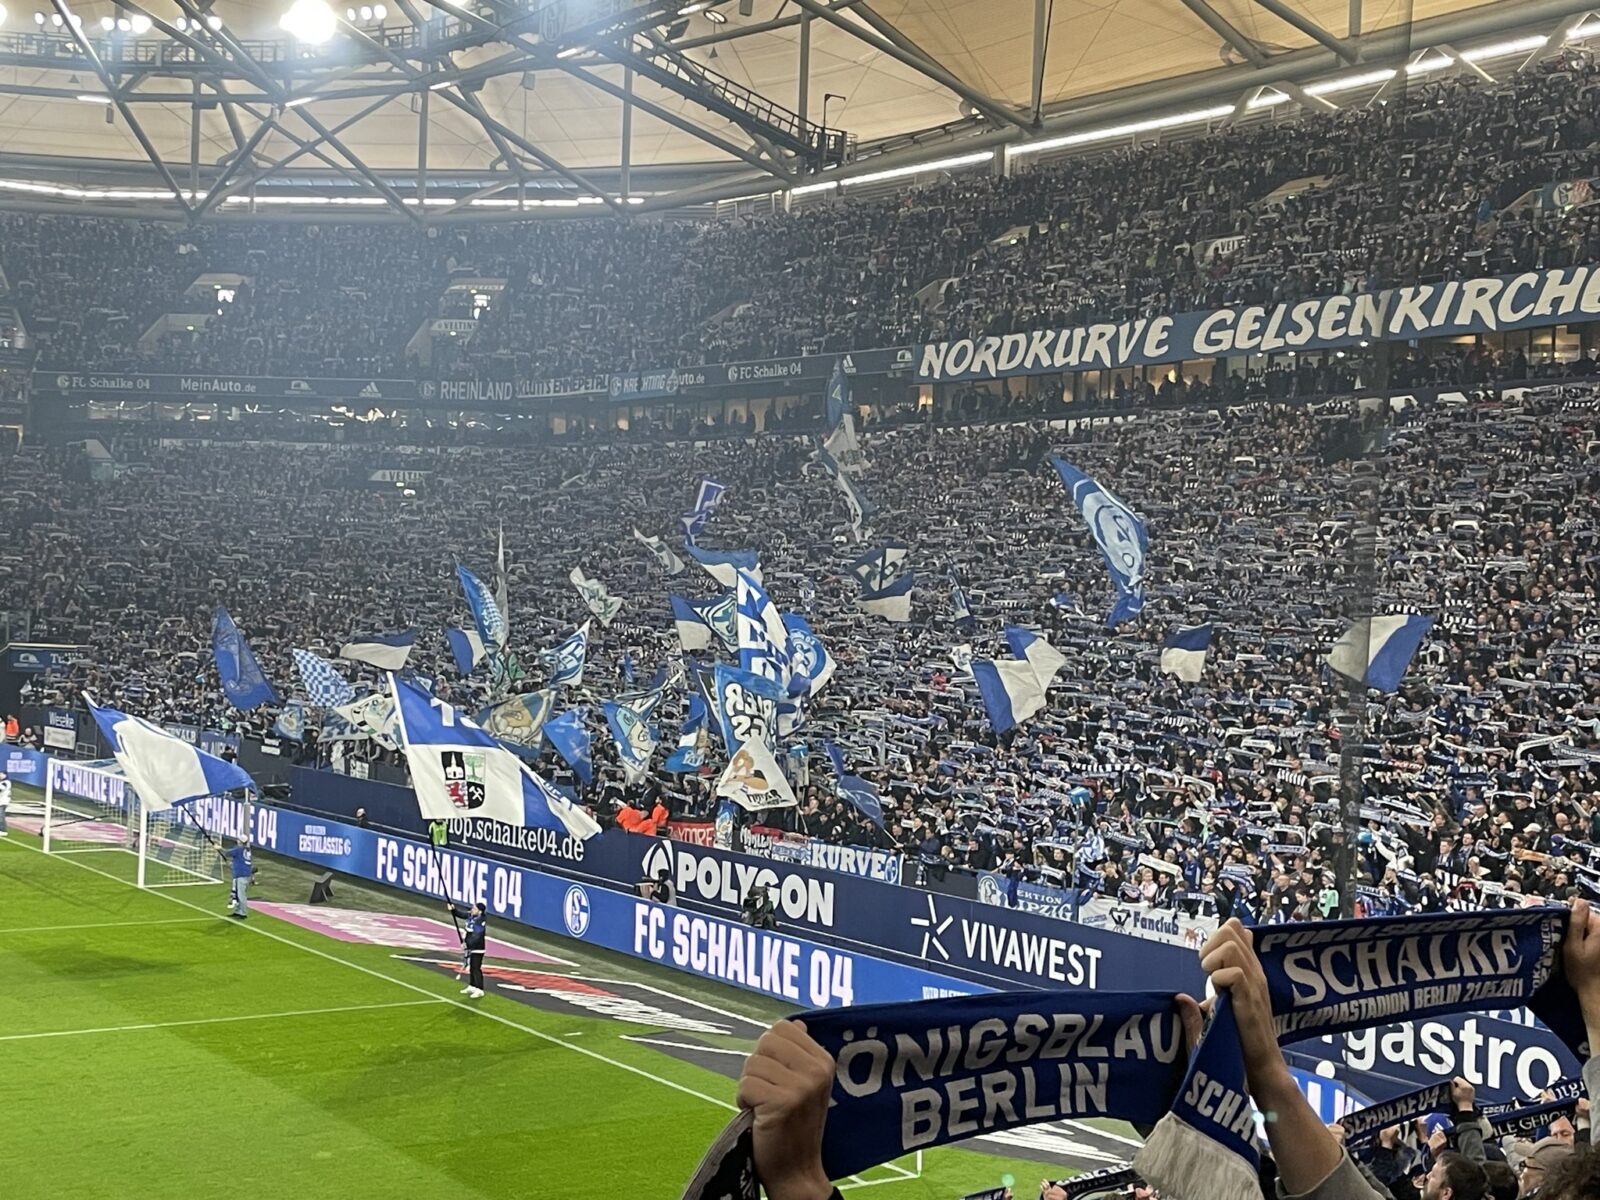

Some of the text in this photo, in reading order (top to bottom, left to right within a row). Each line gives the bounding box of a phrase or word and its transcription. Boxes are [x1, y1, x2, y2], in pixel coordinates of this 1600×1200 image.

[740, 361, 802, 379] FC Schalke 04
[919, 319, 1173, 379] NORDKURVE
[72, 377, 150, 389] FC Schalke 04
[180, 378, 256, 393] MeinAuto.de
[440, 381, 513, 400] RHEINLAND
[258, 808, 278, 850] 04
[376, 838, 523, 918] FC SCHALKE 04
[811, 843, 886, 880] KURVE
[676, 852, 835, 927] POLYGON
[1016, 888, 1063, 906] EKTION
[1133, 910, 1180, 936] Fanclub
[634, 902, 853, 1007] FC SCHALKE 04
[961, 918, 1103, 990] VIVAWEST
[1283, 929, 1524, 1007] SCHALKE
[1413, 982, 1462, 1010] BERLIN
[834, 1013, 1181, 1098] ÖNIGSBLAU
[900, 1062, 1110, 1151] BERLIN
